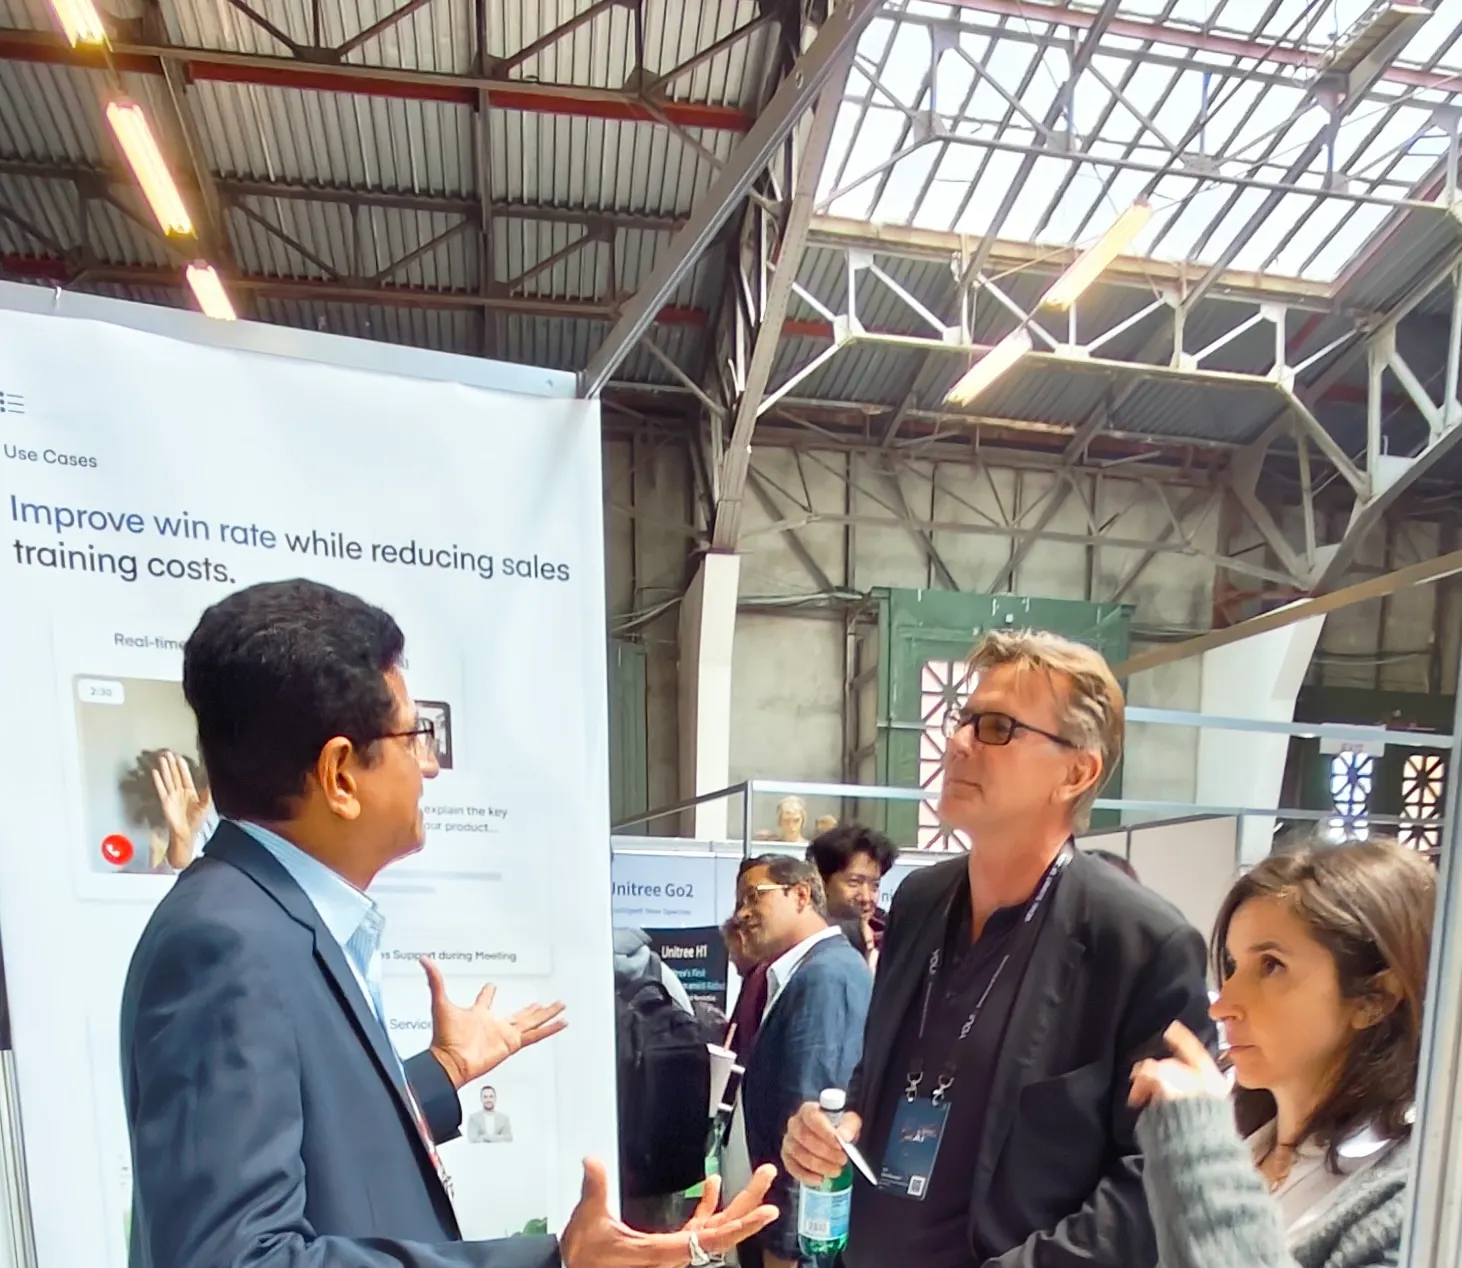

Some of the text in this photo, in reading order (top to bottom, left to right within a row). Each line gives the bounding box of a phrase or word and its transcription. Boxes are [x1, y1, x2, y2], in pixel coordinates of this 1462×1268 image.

[3, 443, 98, 468] Use Cases
[10, 494, 570, 582] Improve win rate while reducing sales
[13, 539, 236, 584] training costs.
[424, 804, 508, 820] explain the key
[665, 883, 694, 898] Go2
[438, 950, 473, 963] during
[475, 951, 517, 963] Meeting
[661, 945, 695, 959] Unitree
[389, 1017, 432, 1030] Servic
